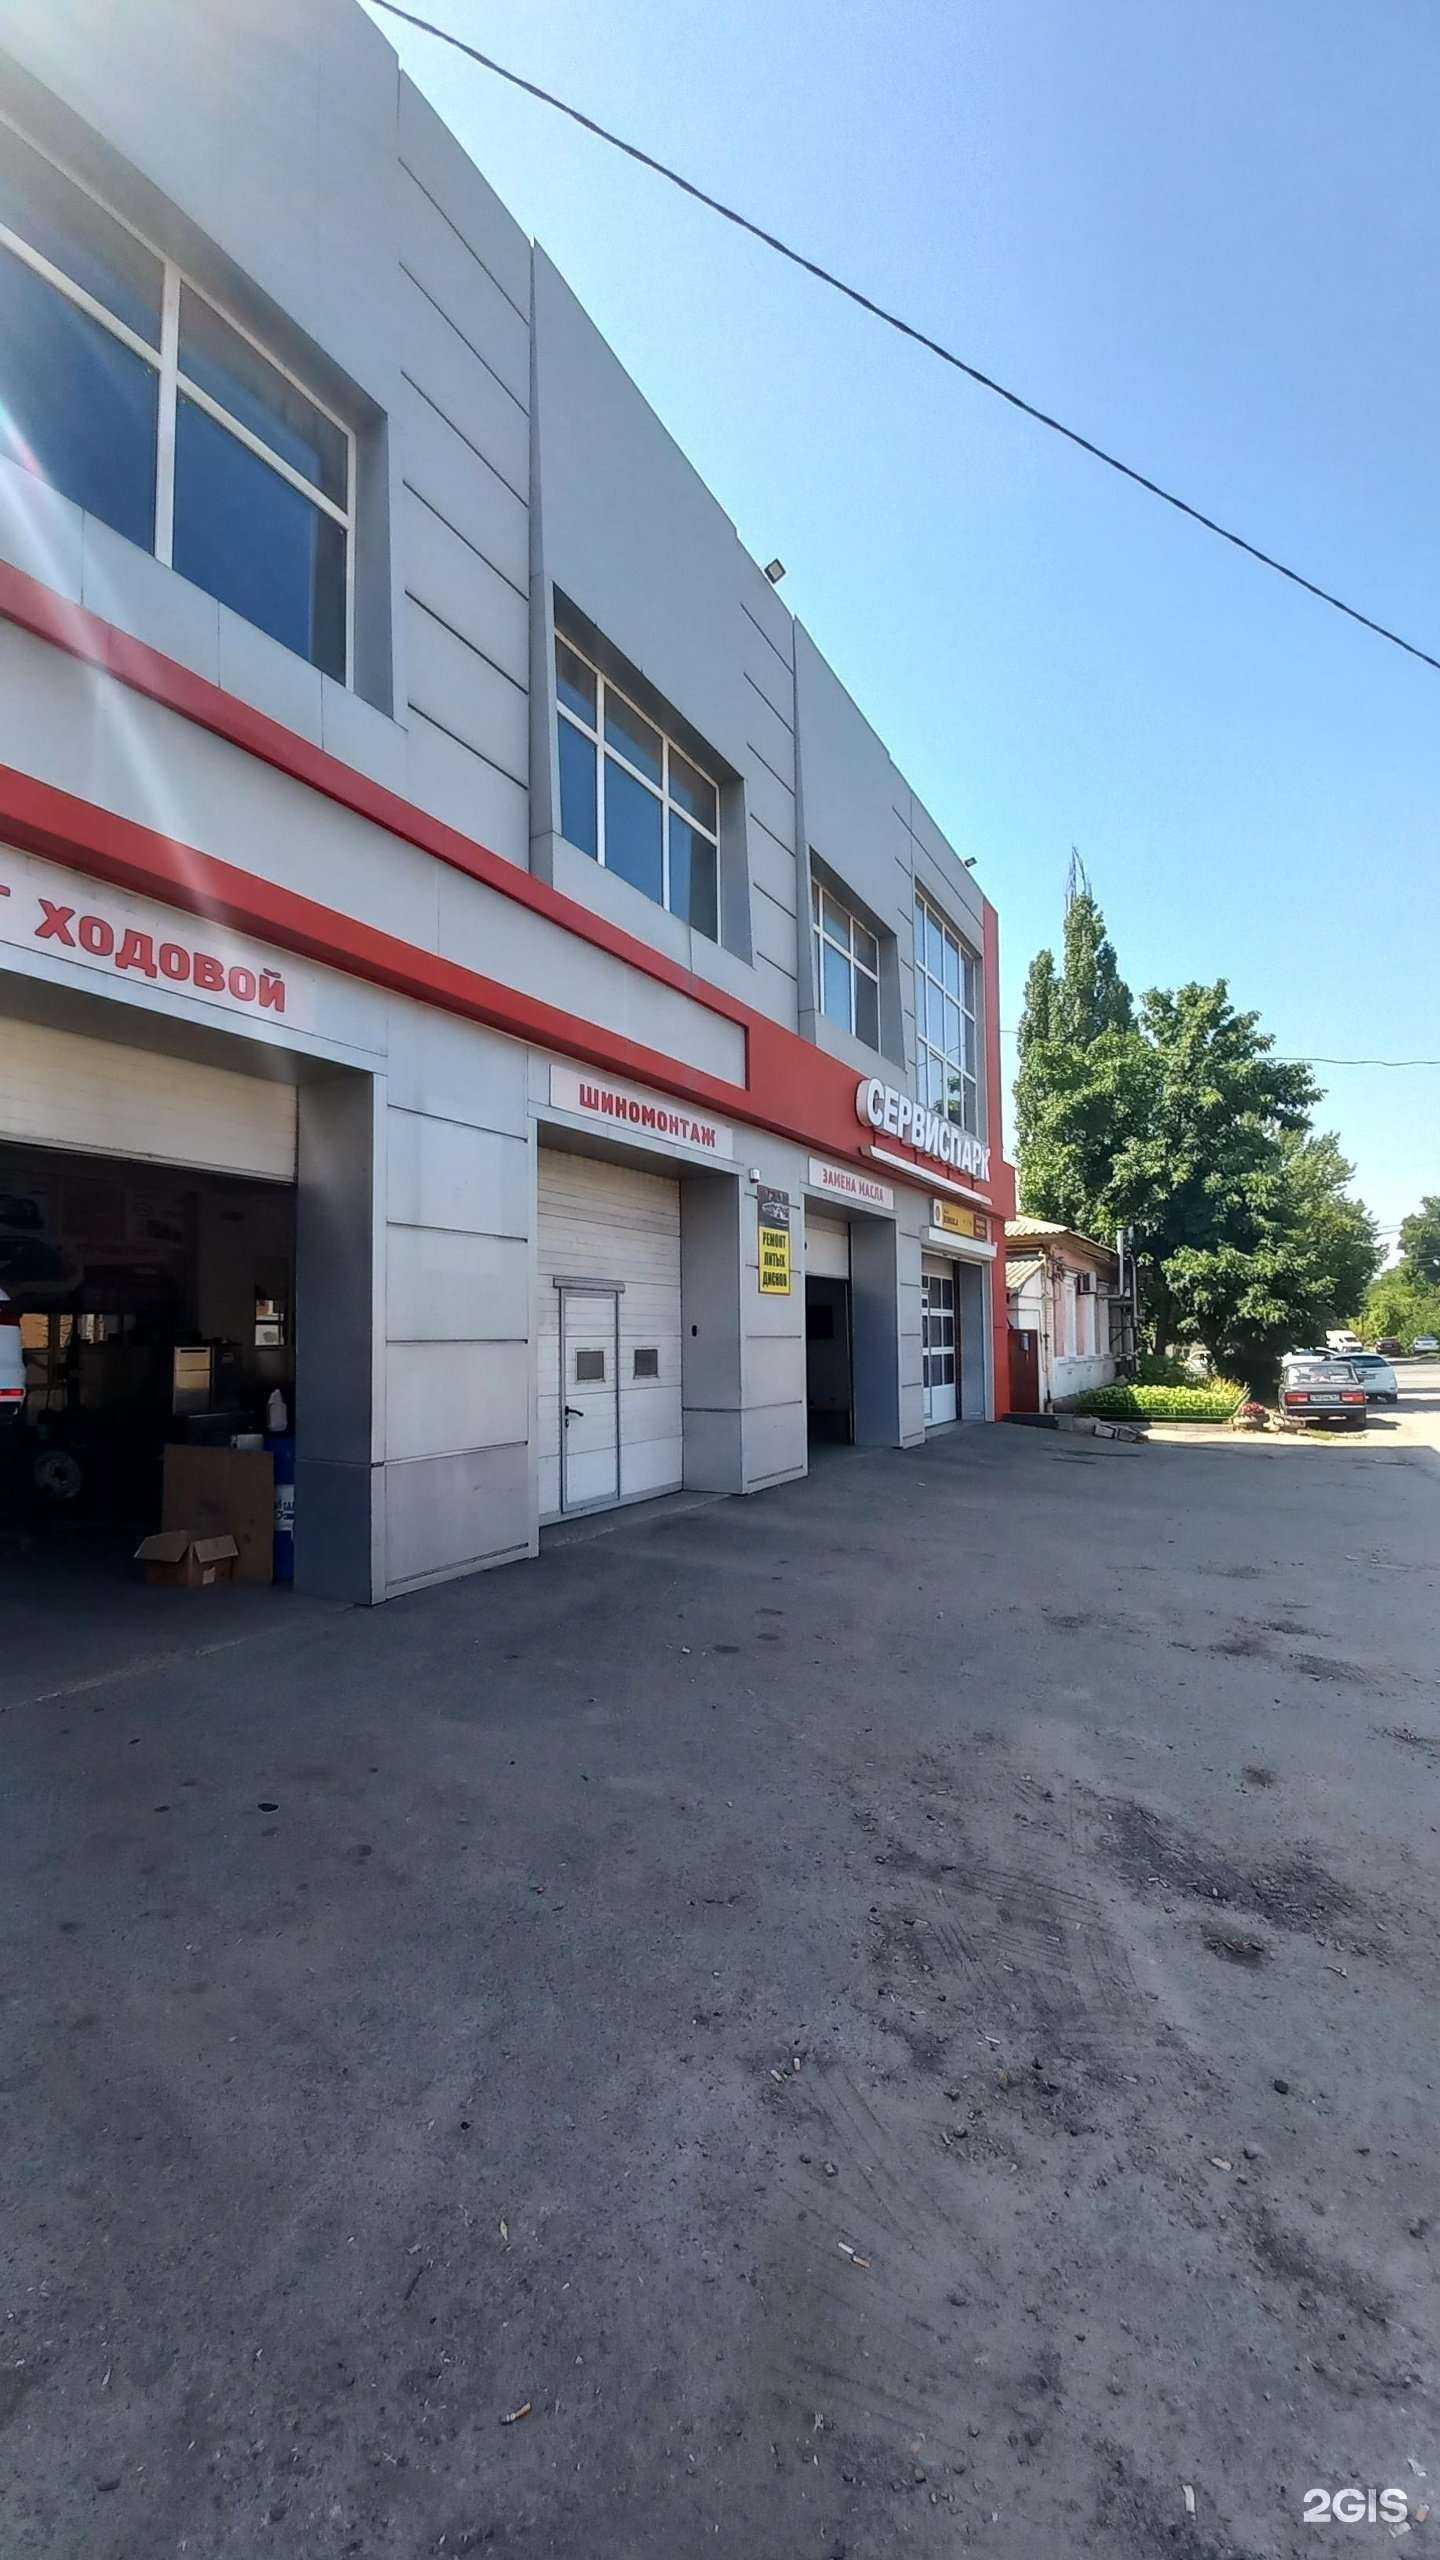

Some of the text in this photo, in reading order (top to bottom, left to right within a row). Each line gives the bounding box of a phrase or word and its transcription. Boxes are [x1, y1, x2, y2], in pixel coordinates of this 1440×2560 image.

[34, 898, 286, 1013] ХОДОВОЙ
[579, 1083, 716, 1149] ШИНОМОНТАЖ
[857, 1078, 991, 1183] СЕРВИСПАРК
[822, 1168, 884, 1202] ЗАМЕНА МАСЛА
[762, 1231, 786, 1249] РЕМОНТ
[764, 1252, 786, 1268] ЛИТЫХ
[762, 1271, 787, 1288] ДИСКОВ
